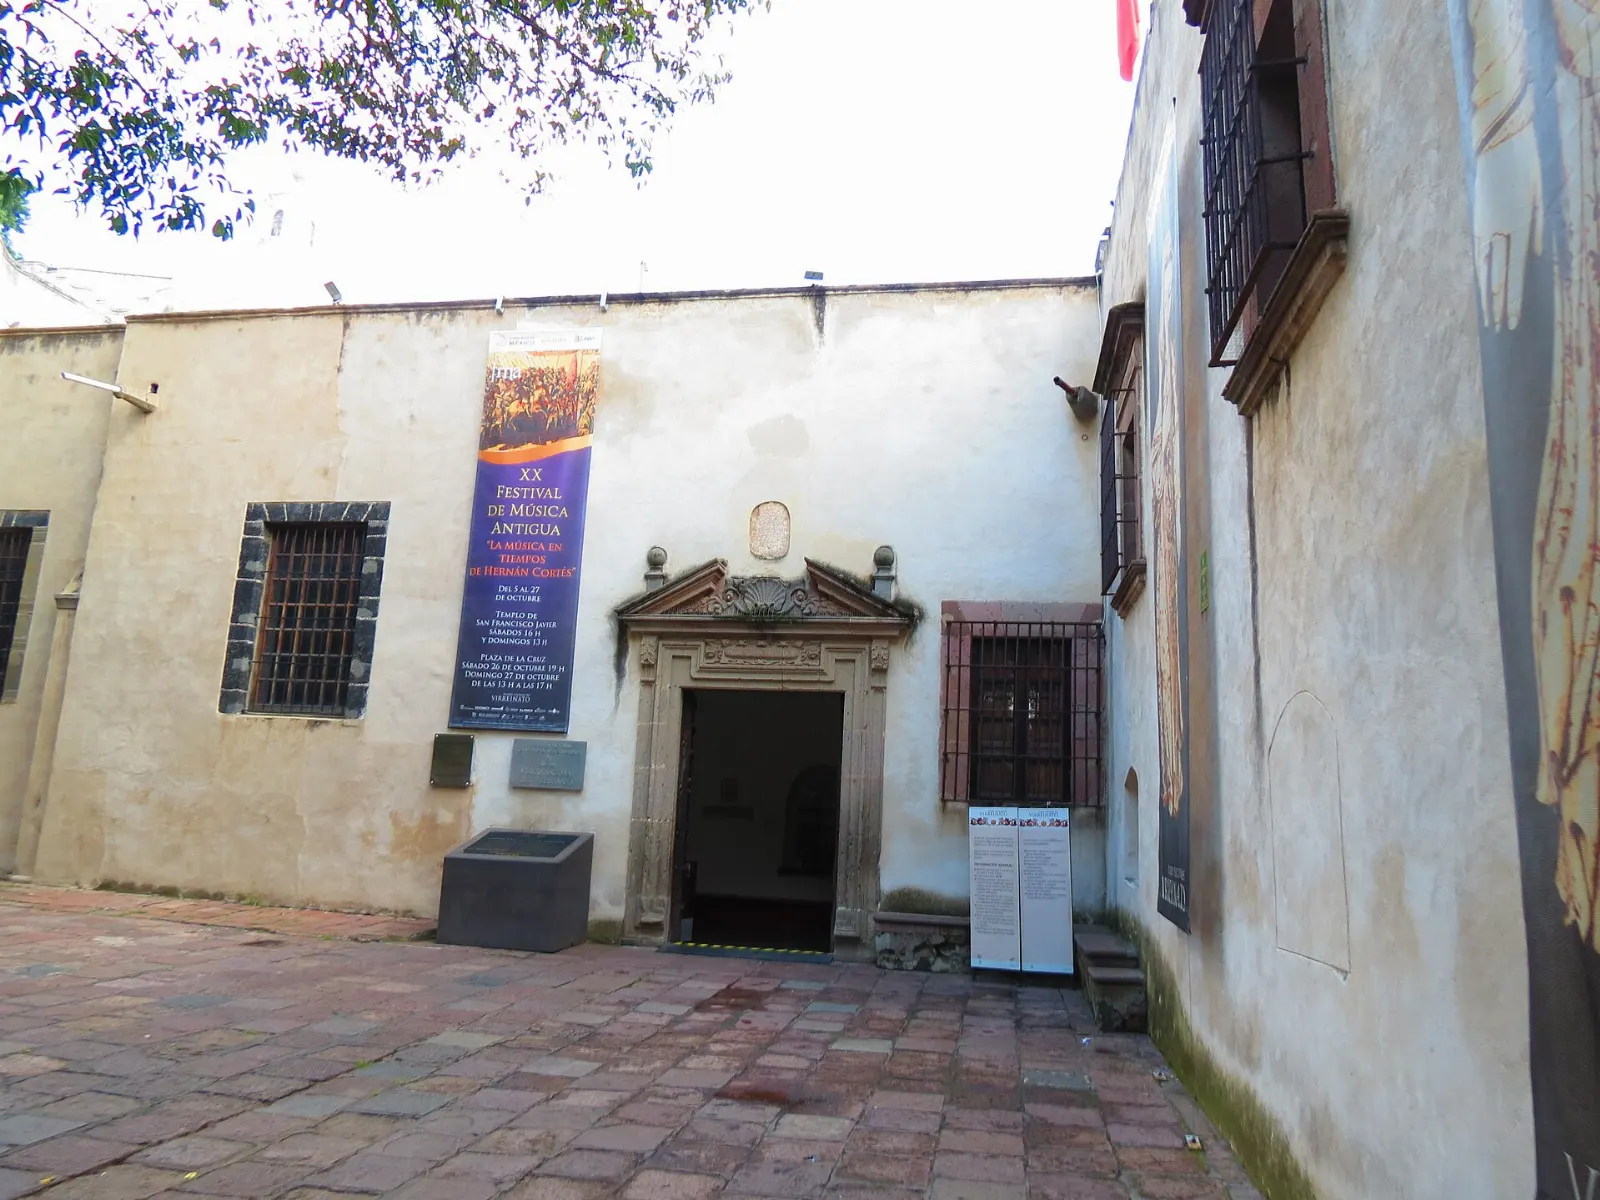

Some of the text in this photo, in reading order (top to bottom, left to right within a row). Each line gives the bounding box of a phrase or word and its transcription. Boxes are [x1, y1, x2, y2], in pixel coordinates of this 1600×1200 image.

[519, 468, 542, 481] XX
[497, 485, 562, 499] FESTIVAL
[488, 503, 568, 517] DE MÚSICA
[491, 521, 560, 535] ANTIGUA
[505, 541, 545, 551] MÚSICA
[549, 543, 562, 551] EN
[500, 555, 546, 564] TIEMPOS
[470, 567, 481, 576] DE
[484, 566, 528, 576] HERNÁN
[492, 620, 533, 628] FRANCISCO
[488, 637, 530, 645] DOMINGOS
[491, 662, 500, 670] 26
[514, 664, 545, 672] OCTUBRE
[465, 671, 502, 679] DOMINGO
